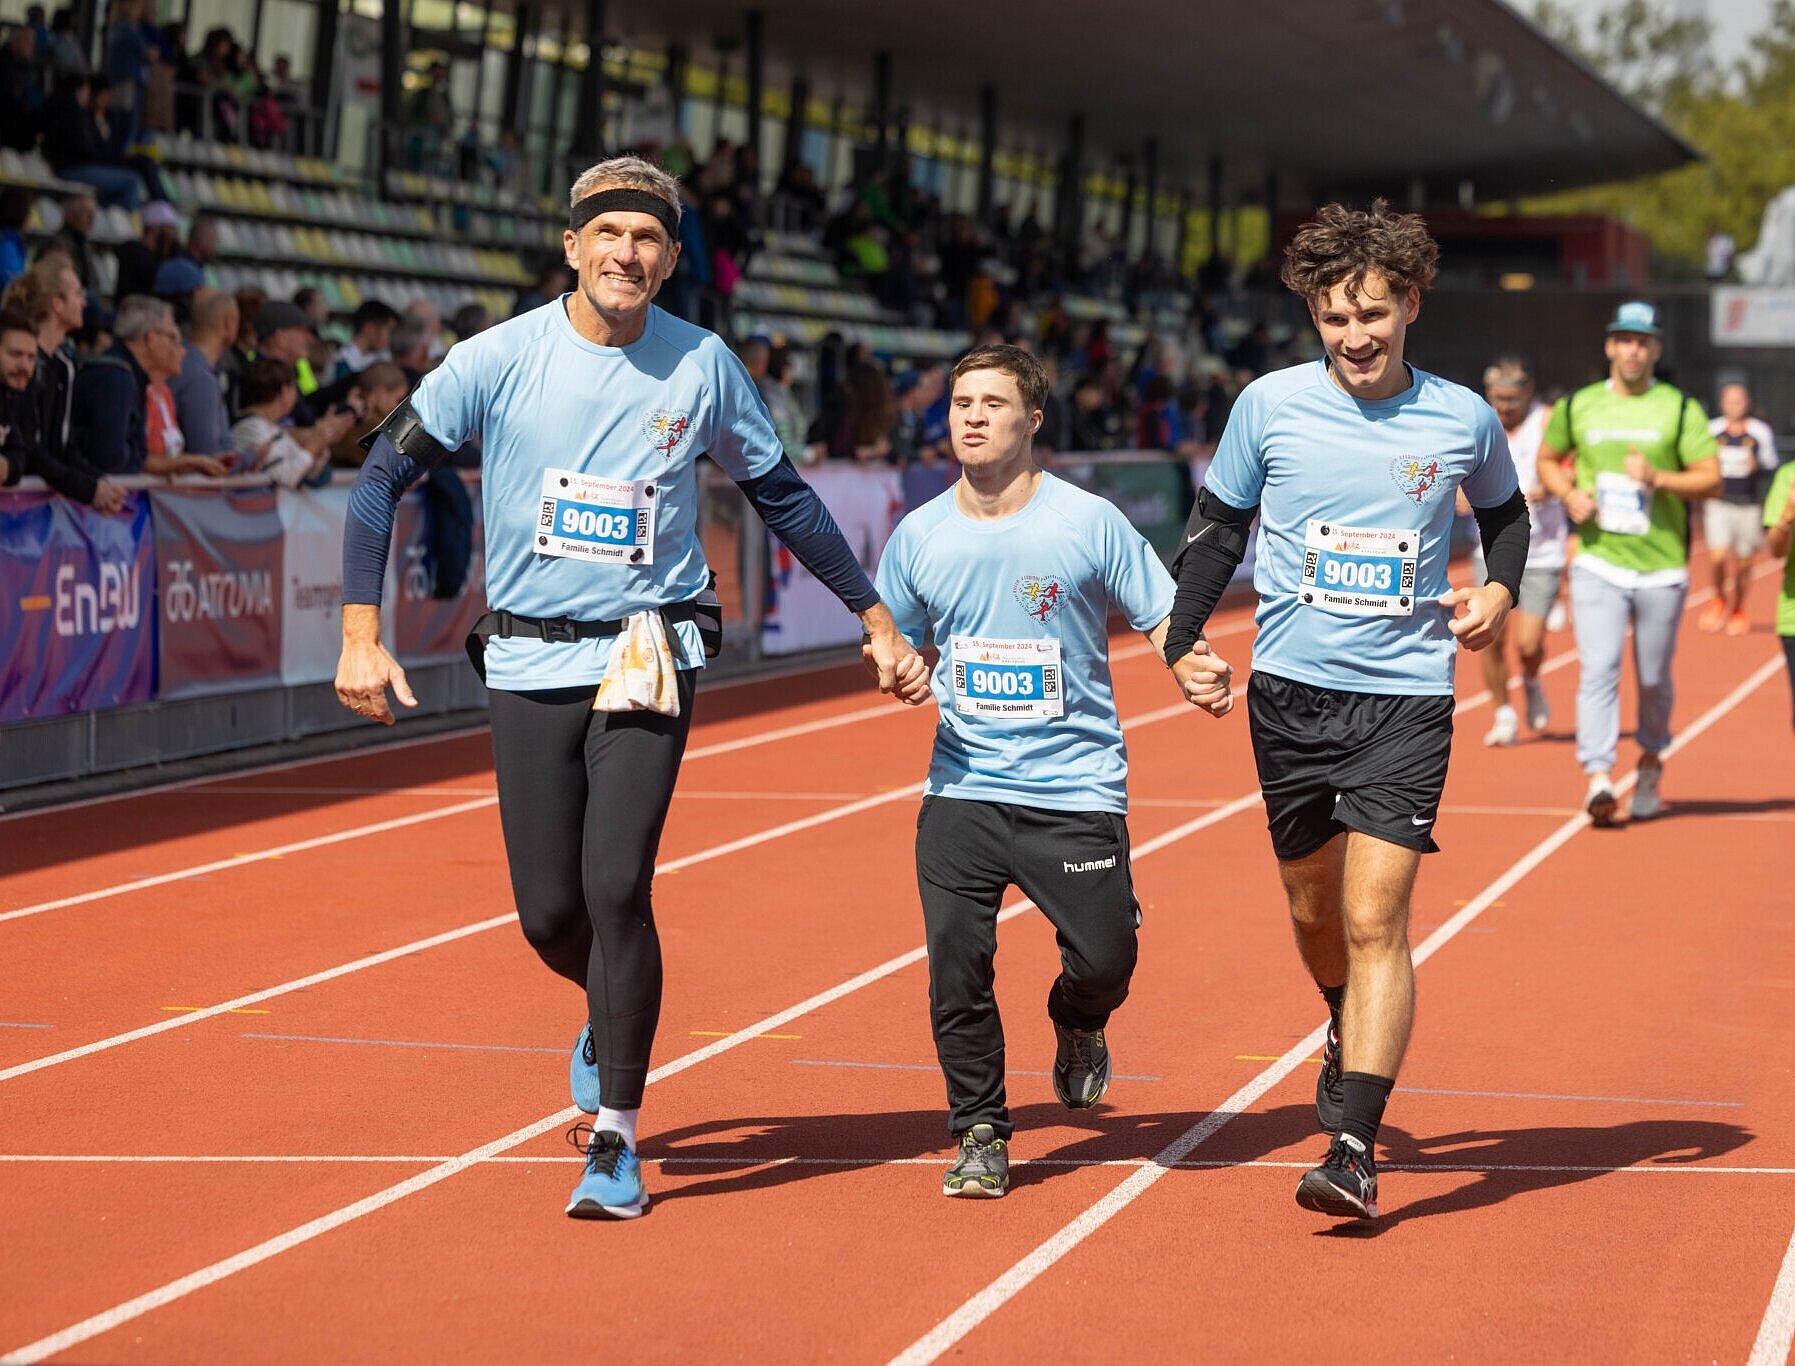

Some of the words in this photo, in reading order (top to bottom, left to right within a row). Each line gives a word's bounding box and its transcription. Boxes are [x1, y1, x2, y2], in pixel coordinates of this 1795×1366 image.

[581, 479, 617, 491] September
[618, 484, 635, 493] 2024
[561, 508, 630, 539] 9003
[1340, 529, 1378, 539] September
[1379, 532, 1396, 540] 2024
[561, 542, 590, 554] Familie
[591, 546, 624, 557] Schmidt
[1324, 559, 1392, 589] 9003
[55, 562, 140, 636] EnBW
[1324, 593, 1353, 605] Familie
[1354, 596, 1388, 608] Schmidt
[982, 641, 1016, 650] September
[972, 669, 1034, 695] 9003
[976, 701, 1001, 711] Familie
[1002, 703, 1034, 712] Schmidt
[1063, 854, 1116, 873] hummel
